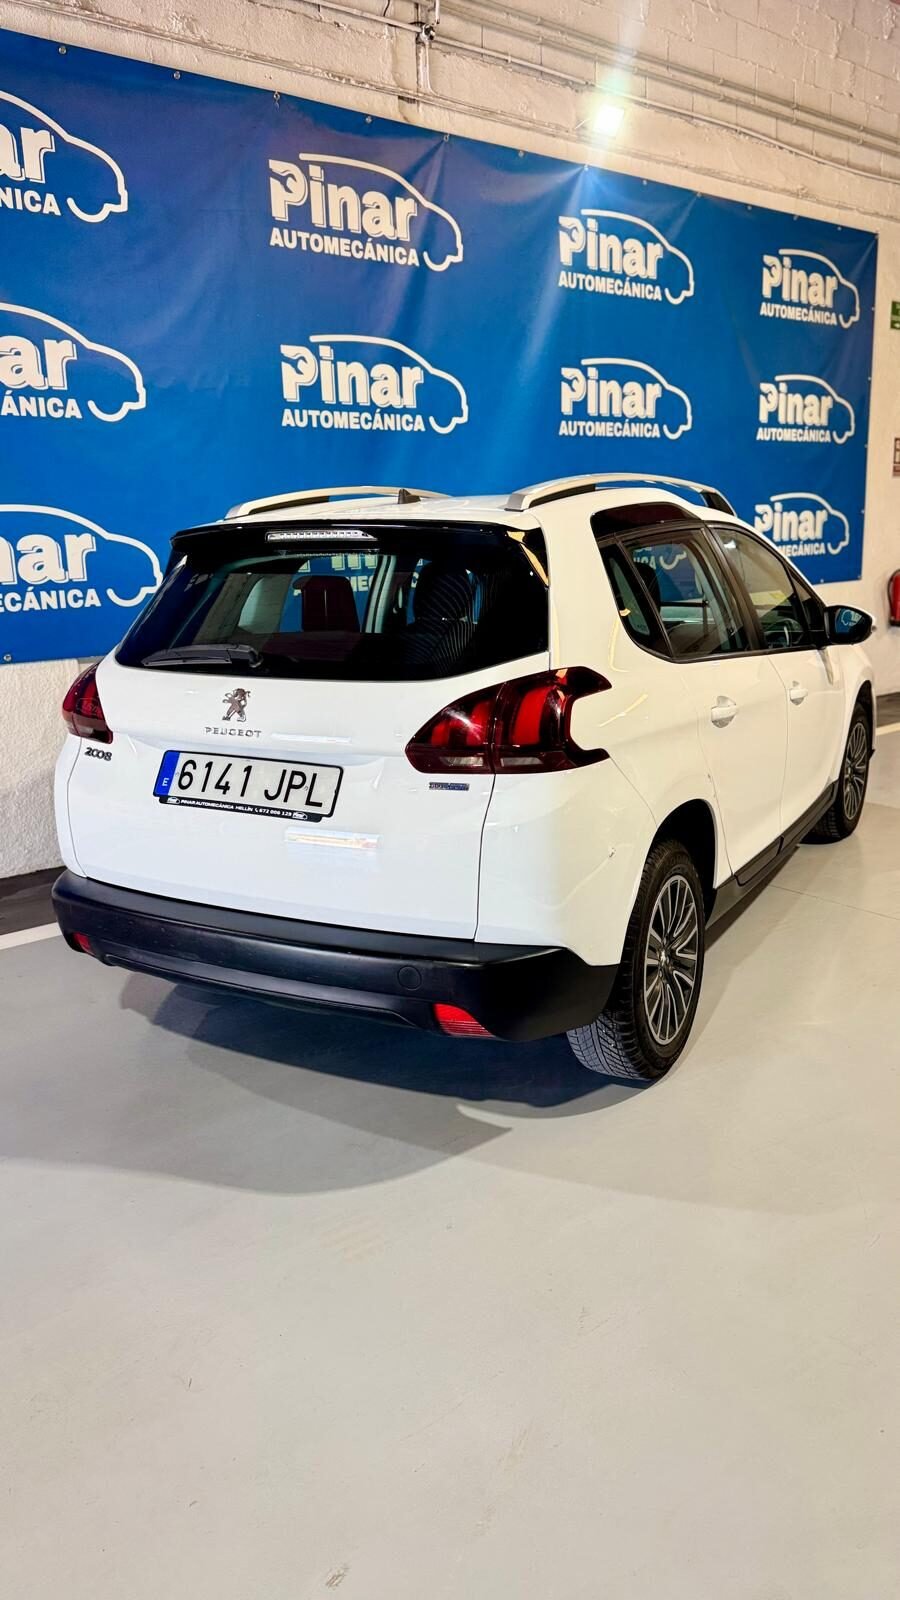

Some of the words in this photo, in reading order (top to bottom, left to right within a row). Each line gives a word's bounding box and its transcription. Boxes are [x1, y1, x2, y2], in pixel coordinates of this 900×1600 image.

[268, 159, 418, 241] Pinar
[269, 227, 420, 267] AUTOMECÁNICA
[558, 215, 663, 279] Pinar
[558, 271, 662, 301] AUTOMECÁNICA
[762, 254, 838, 308] Pinar
[759, 301, 837, 326] AUTOMECÁNICA
[280, 344, 424, 409] Pinar
[561, 366, 662, 419] Pinar
[281, 408, 425, 432] AUTOMECÁNICA
[759, 382, 833, 427] Pinar
[558, 419, 661, 439] AUTOMECÁNICA
[756, 426, 831, 443] AUTOMECÁNICA
[204, 726, 263, 738] PEUGEOT
[84, 746, 113, 762] 2008
[161, 777, 170, 787] E
[177, 759, 253, 798] 6141
[263, 769, 324, 808] JPL
